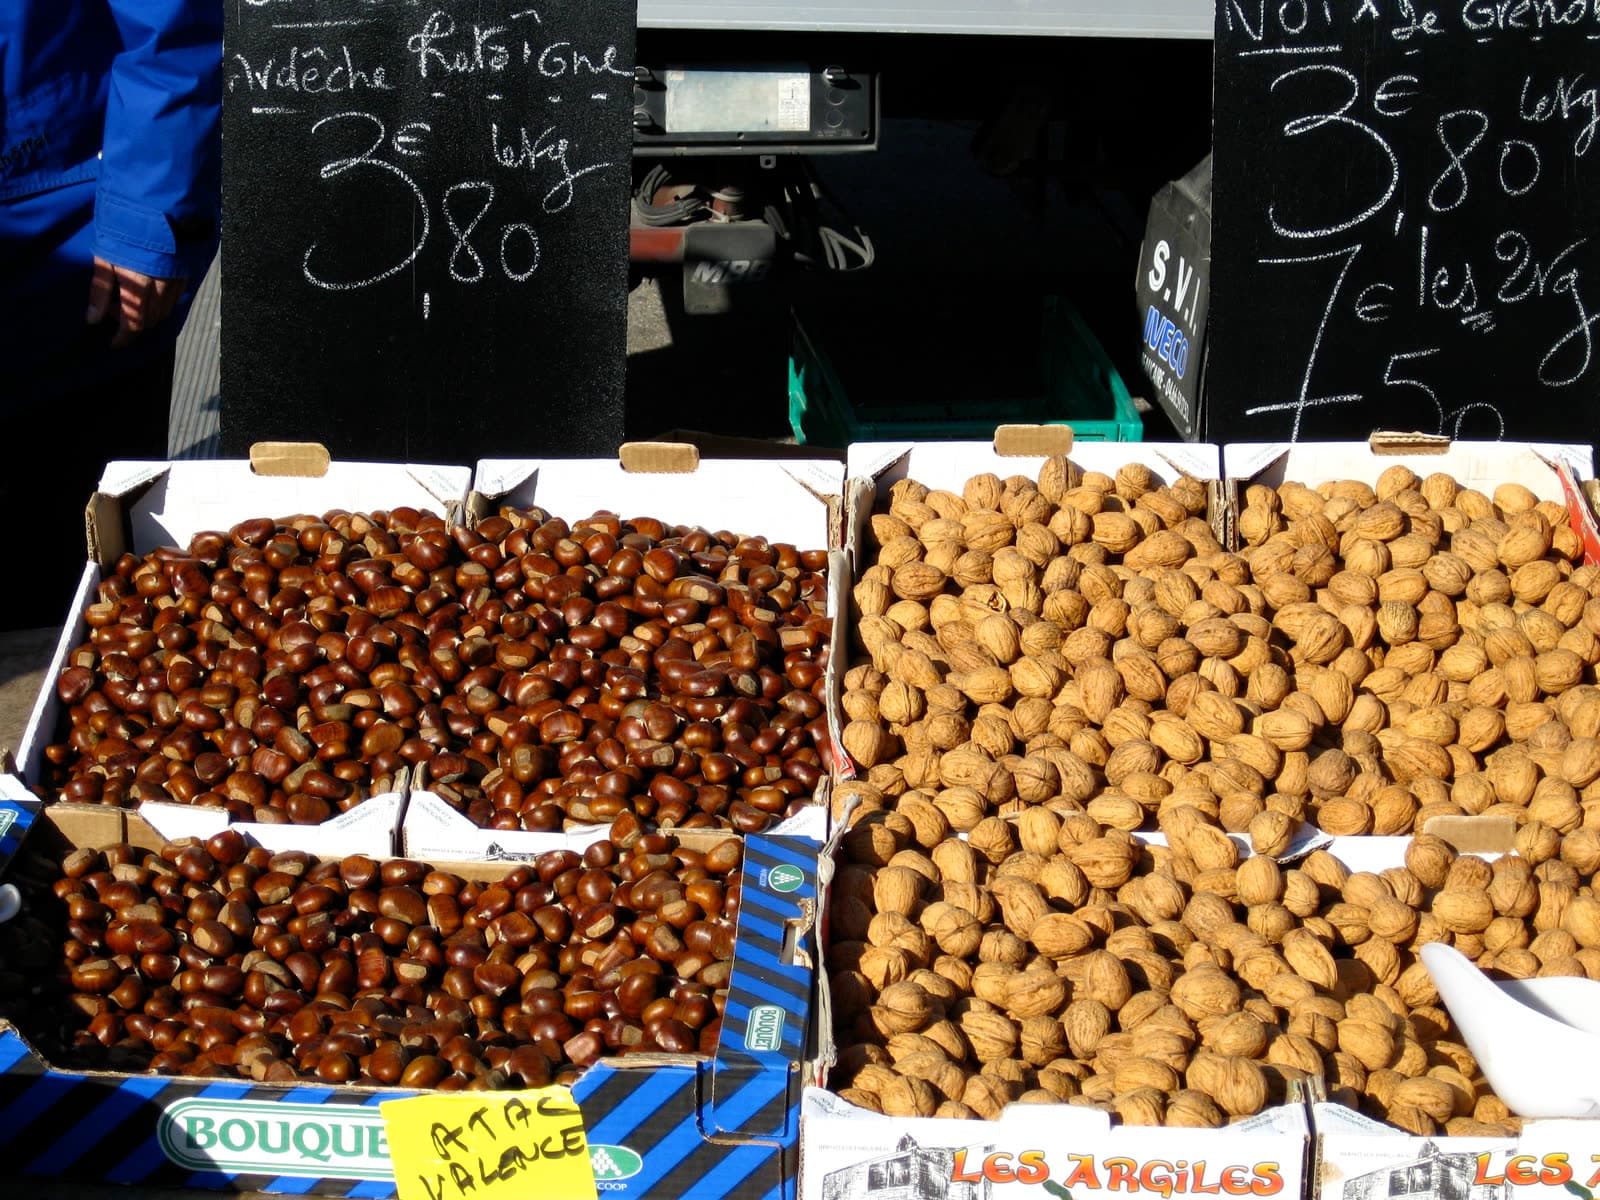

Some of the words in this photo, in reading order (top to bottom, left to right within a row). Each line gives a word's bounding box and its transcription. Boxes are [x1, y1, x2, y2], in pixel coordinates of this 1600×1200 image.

[1143, 304, 1190, 380] IVECO
[754, 1009, 777, 1050] BOUQUET
[430, 1097, 582, 1160] ATAC
[418, 1124, 586, 1200] VALENCE
[950, 1149, 1051, 1185] LES
[1472, 1151, 1574, 1187] LES
